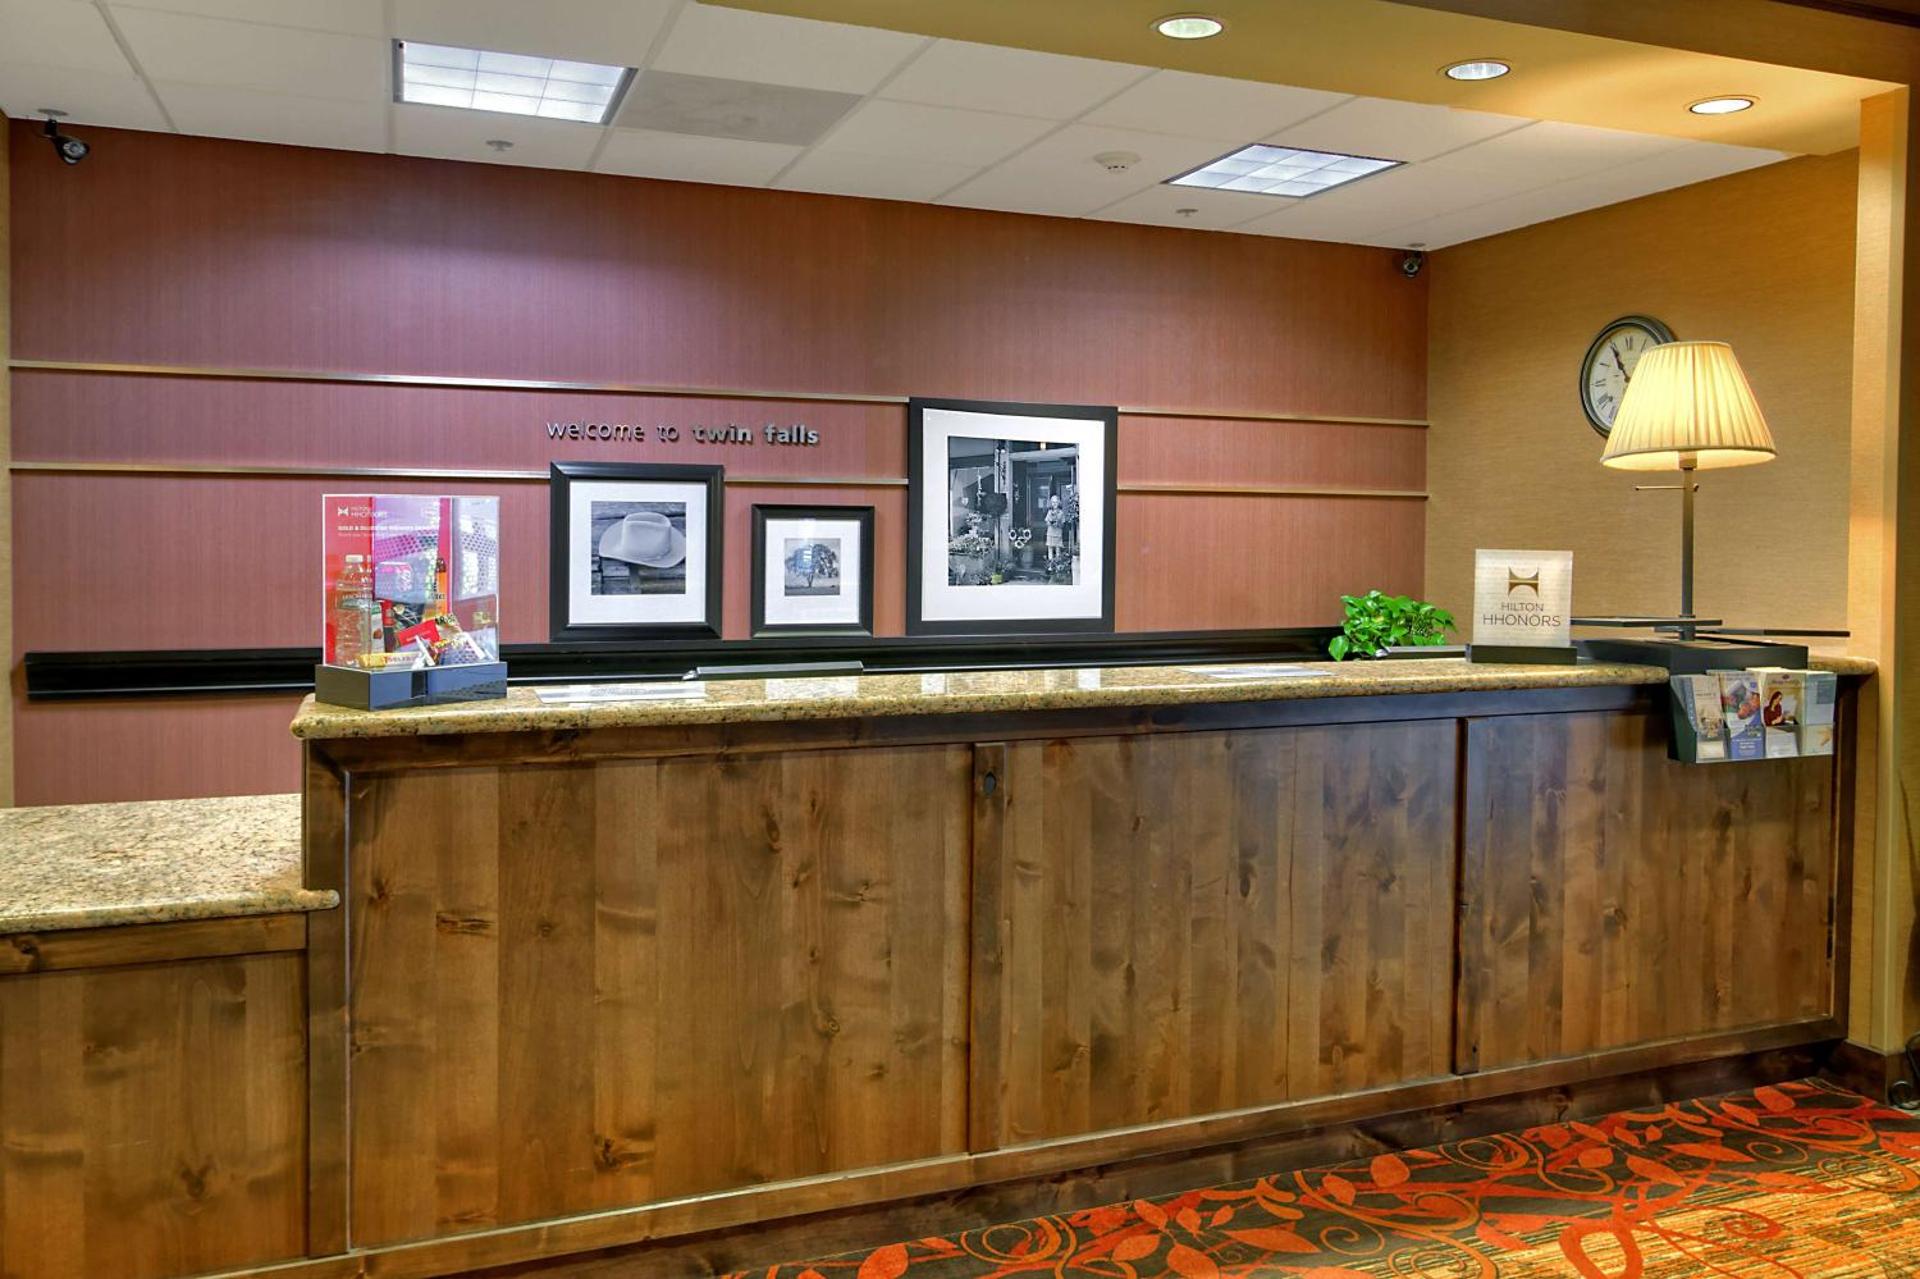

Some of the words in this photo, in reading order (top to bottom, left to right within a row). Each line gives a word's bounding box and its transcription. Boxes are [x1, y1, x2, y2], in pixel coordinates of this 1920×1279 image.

[546, 420, 644, 442] welcome
[657, 424, 680, 442] to
[694, 424, 753, 444] twin
[765, 424, 820, 445] falls
[1501, 602, 1545, 612] HILTON
[1482, 614, 1561, 627] HHONORS
